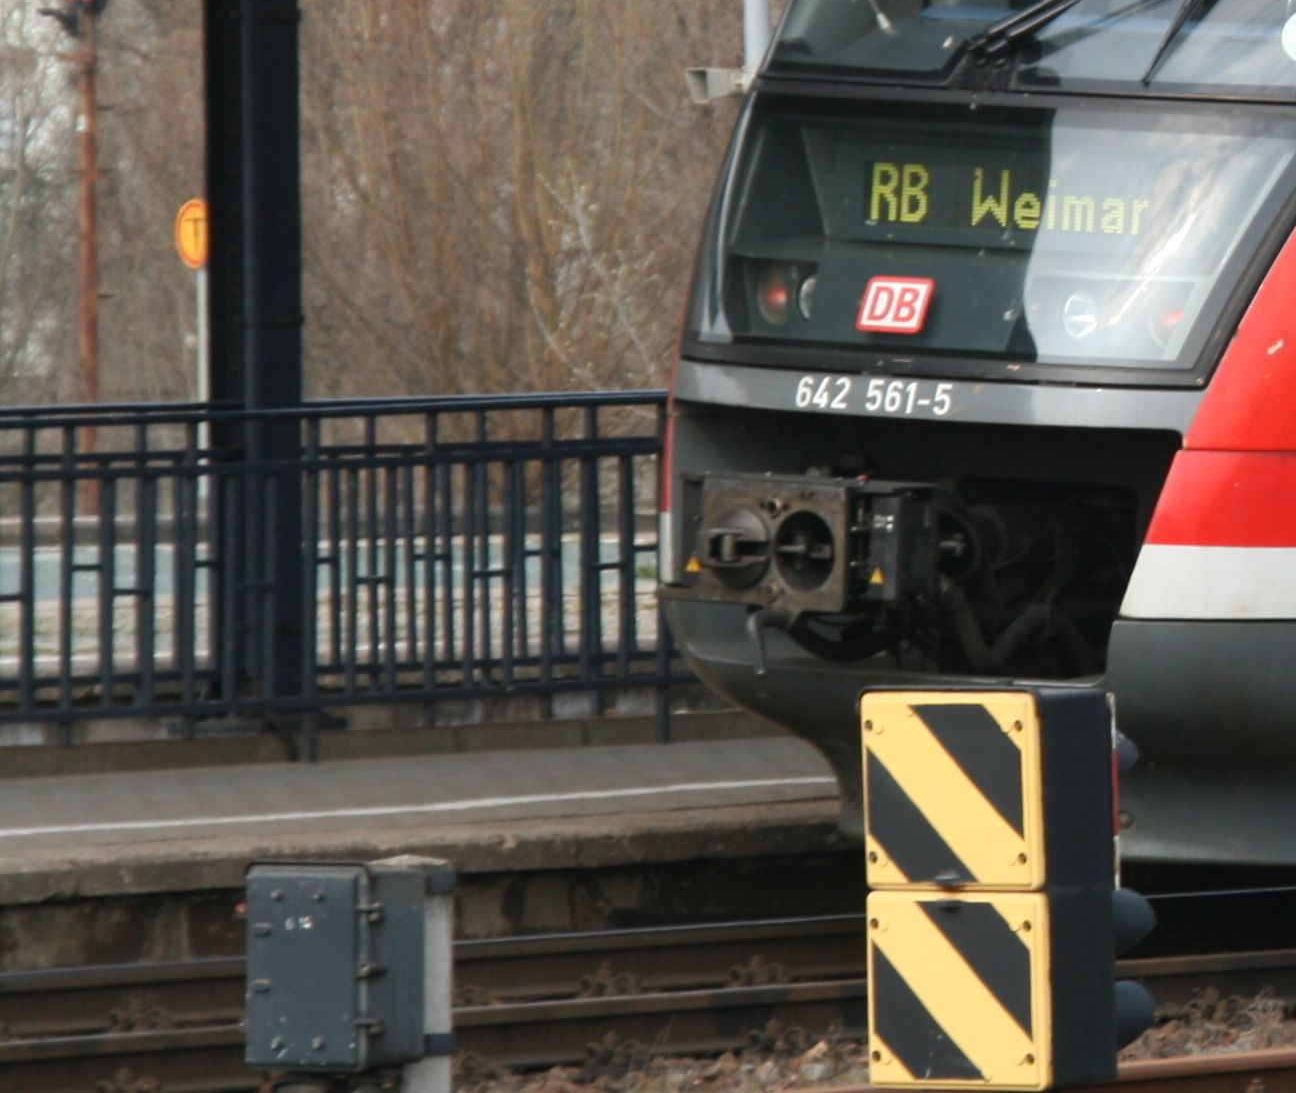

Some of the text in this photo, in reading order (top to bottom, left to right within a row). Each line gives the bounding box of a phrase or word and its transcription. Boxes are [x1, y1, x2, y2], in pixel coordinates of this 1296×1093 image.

[869, 162, 1149, 235] RB Weimar
[866, 286, 919, 323] DB
[795, 376, 953, 415] 642 561-5
